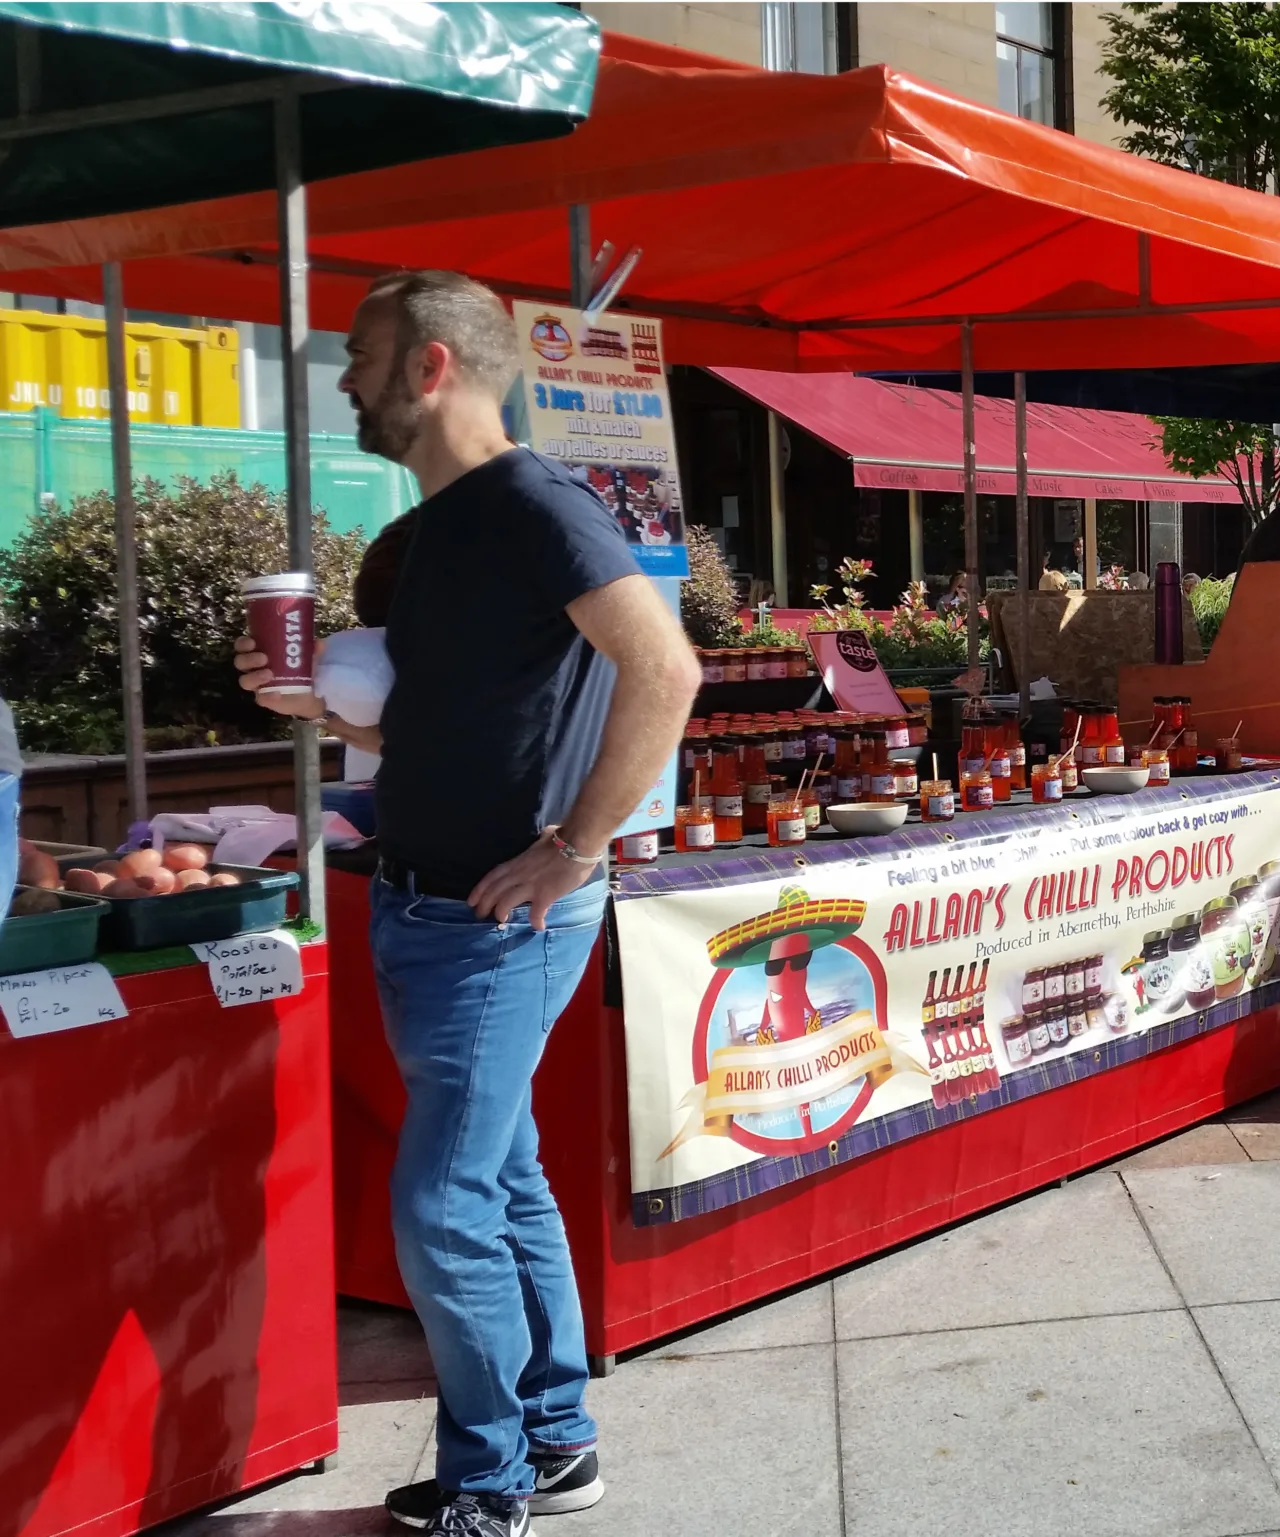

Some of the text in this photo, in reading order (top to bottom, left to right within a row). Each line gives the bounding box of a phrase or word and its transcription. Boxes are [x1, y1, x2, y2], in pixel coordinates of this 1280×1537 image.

[605, 373, 654, 390] PRODUCTS
[76, 387, 149, 412] 10000
[567, 416, 591, 435] mix
[602, 419, 642, 439] match
[623, 445, 668, 462] sauces
[879, 469, 918, 484] Coffee
[957, 473, 997, 489] Pinis
[1033, 479, 1063, 493] Music
[1095, 482, 1123, 495] Cakes
[1152, 485, 1176, 497] Wine
[1203, 488, 1224, 500] Soup
[286, 610, 301, 669] COSTA
[838, 641, 877, 660] taste
[888, 866, 938, 887] Feeling
[941, 865, 950, 877] a
[951, 857, 967, 874] bit
[969, 855, 995, 872] blue
[1070, 837, 1091, 853] Put
[1093, 831, 1122, 848] some
[1158, 817, 1181, 835] back
[1183, 816, 1190, 830] &
[1192, 814, 1207, 832] get
[1210, 810, 1229, 826] cozy
[884, 833, 1235, 951] ALLAN'S CHILLI PRODUCTS
[975, 897, 1177, 958] Produced in Abernethy, Perthshire
[724, 1031, 877, 1092] ALLAN'S CHILLI PRODUCTS
